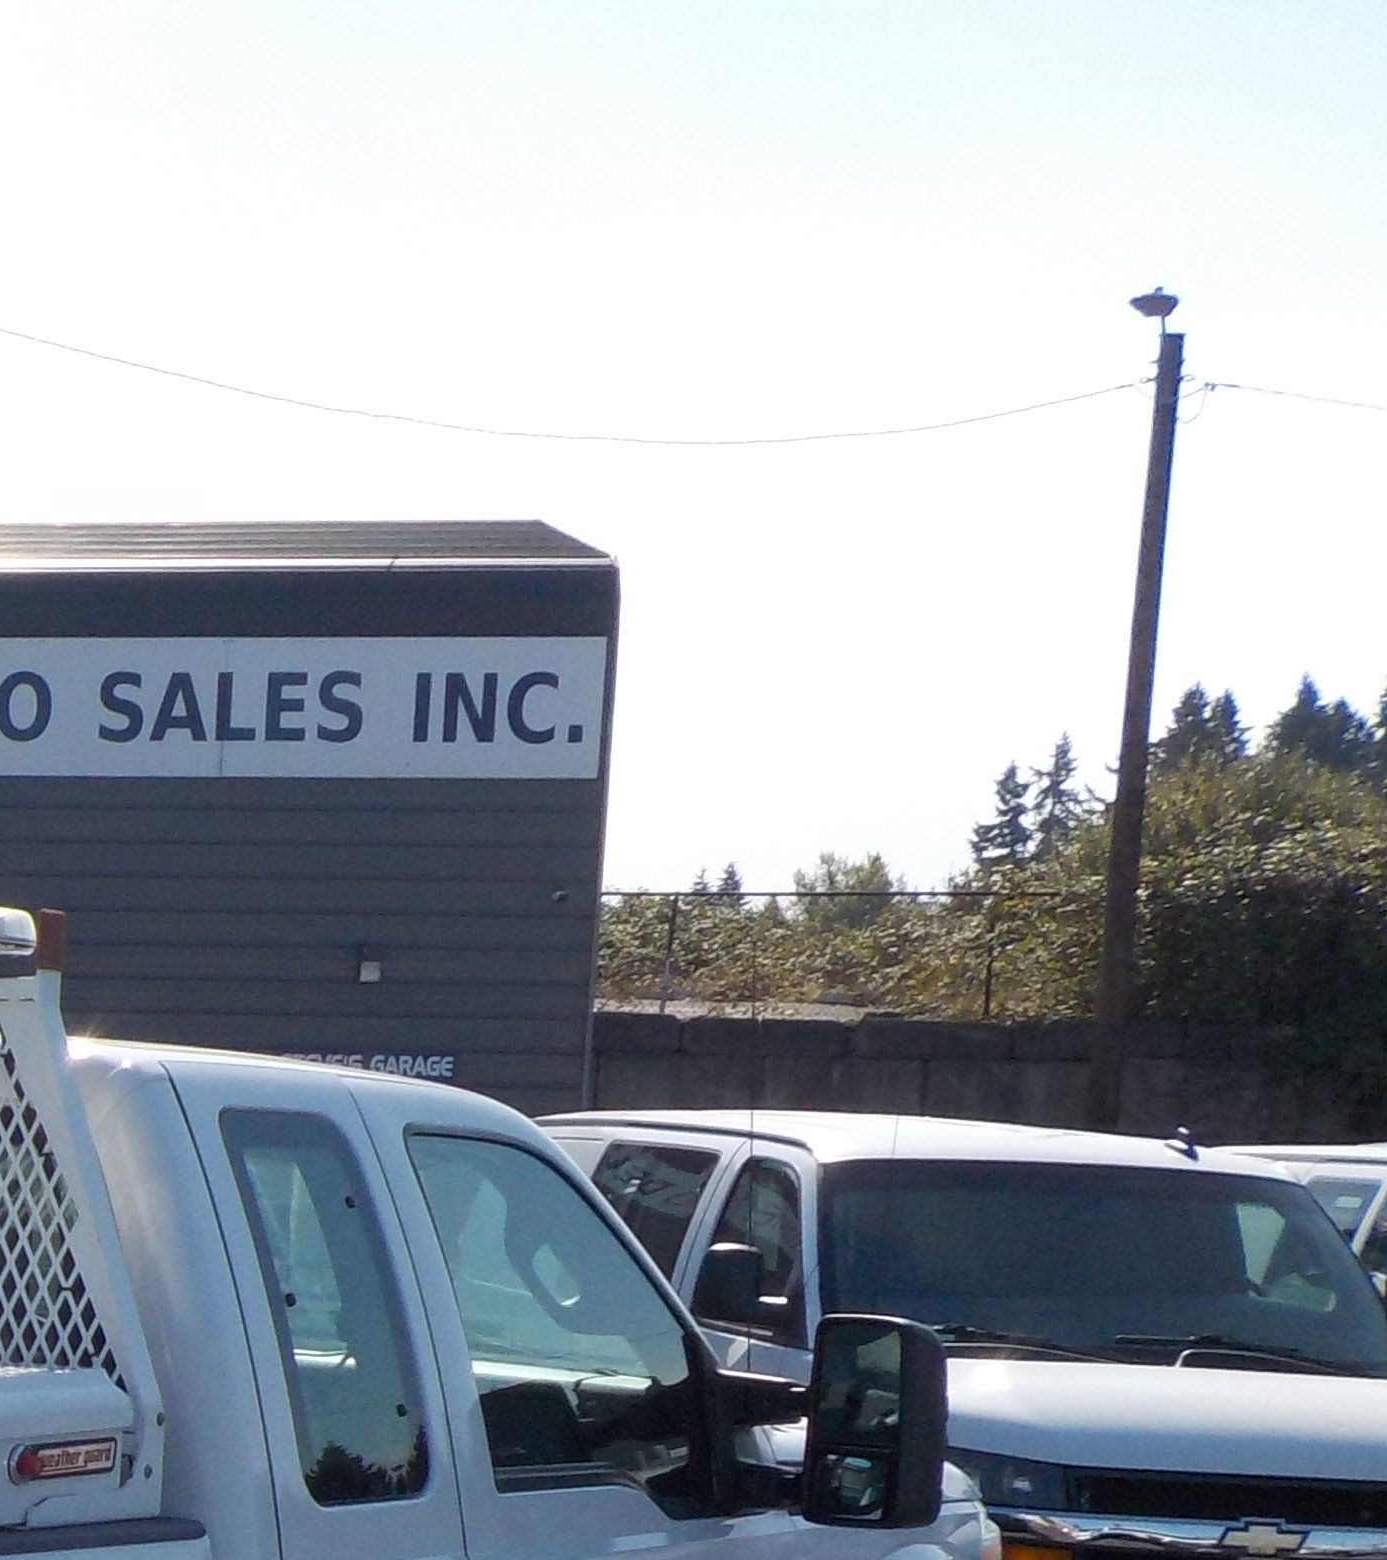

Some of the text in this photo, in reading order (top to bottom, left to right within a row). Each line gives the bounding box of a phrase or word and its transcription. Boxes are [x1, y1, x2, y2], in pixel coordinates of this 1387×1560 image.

[97, 670, 365, 744] SALES
[411, 671, 584, 744] INC.
[370, 1054, 455, 1078] GARAGE
